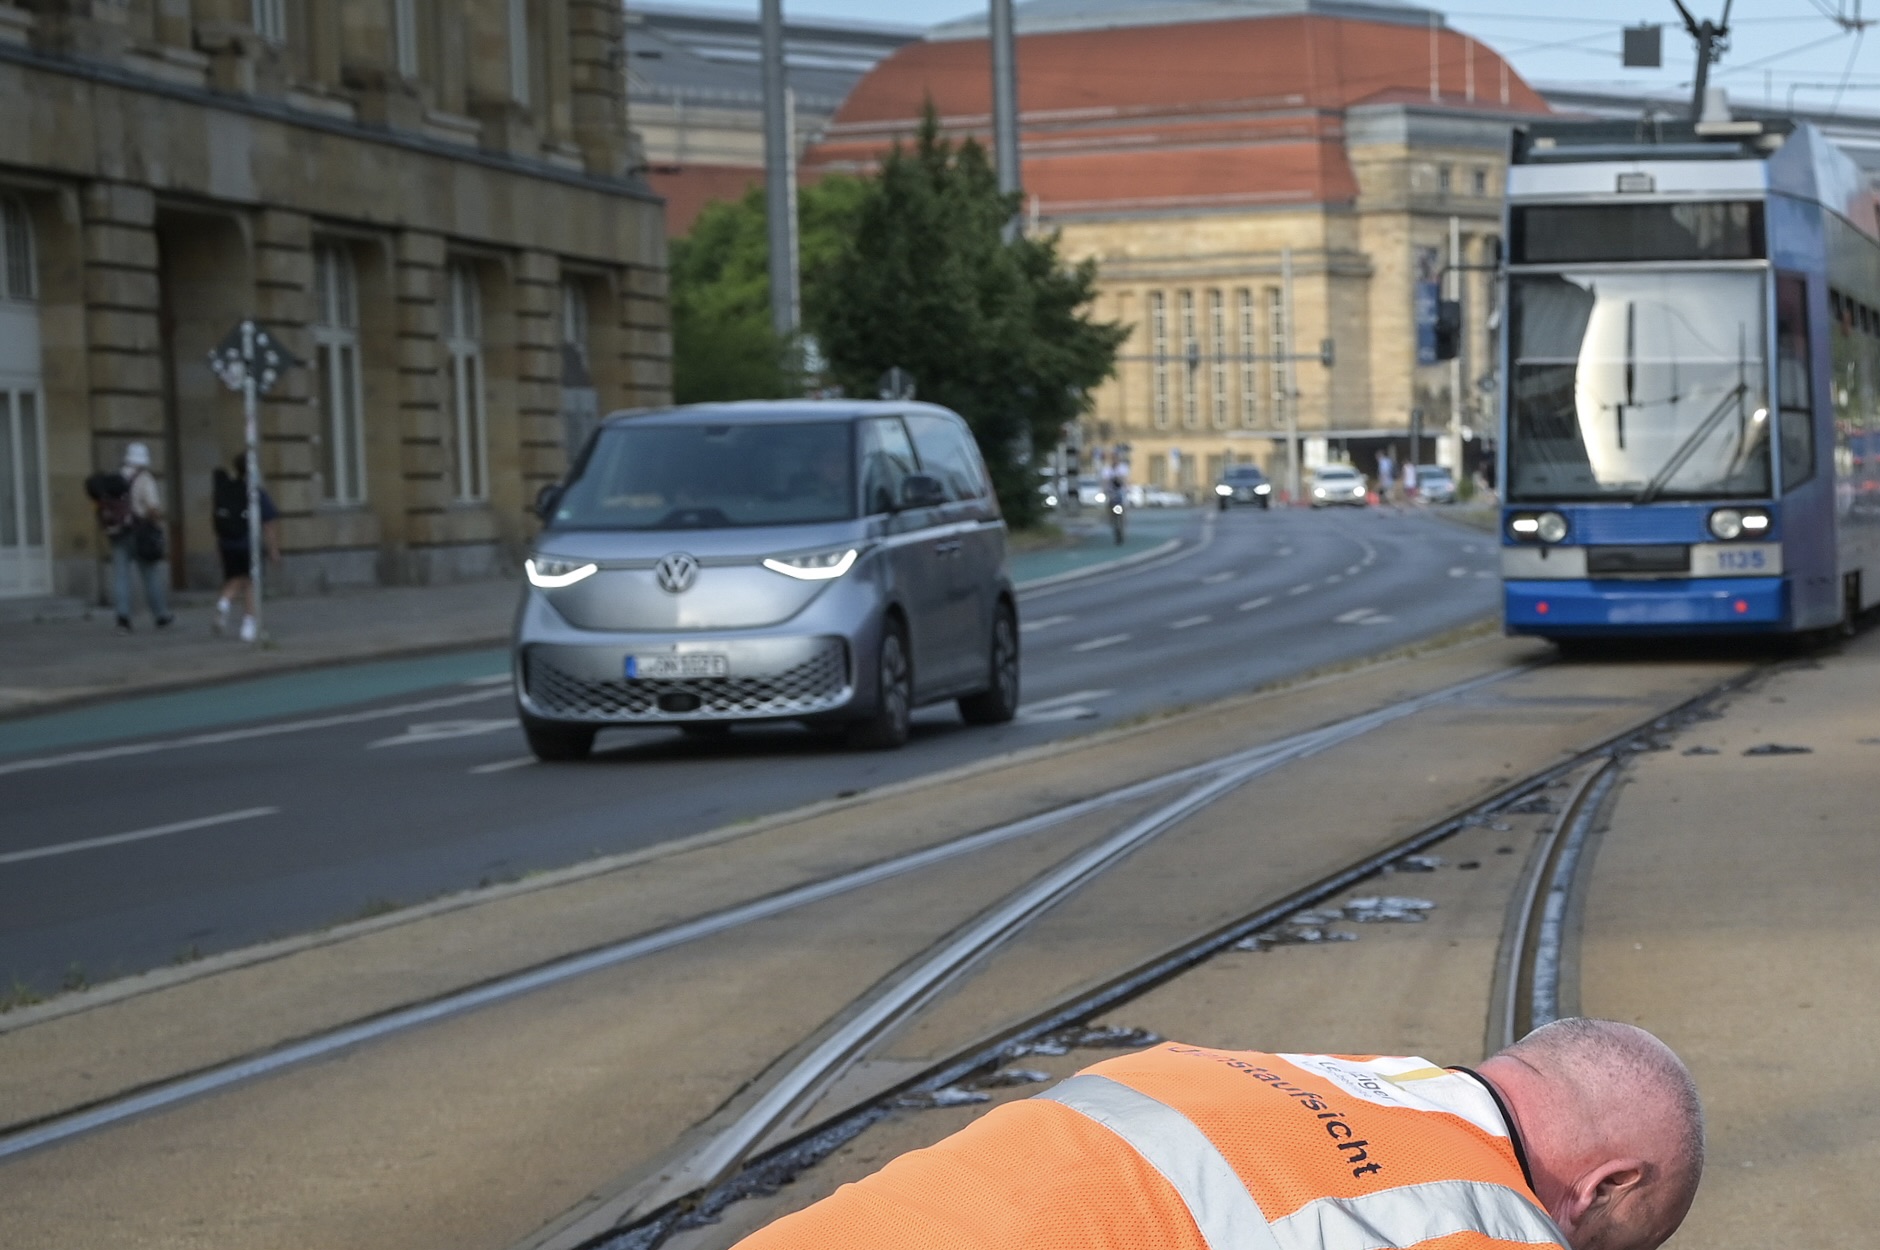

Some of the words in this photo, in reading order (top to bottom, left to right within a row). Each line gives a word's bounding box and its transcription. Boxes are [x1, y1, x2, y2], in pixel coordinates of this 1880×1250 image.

[656, 552, 698, 593] VW
[1318, 1060, 1400, 1104] Leziger
[1167, 1046, 1383, 1179] nstaufsicht
